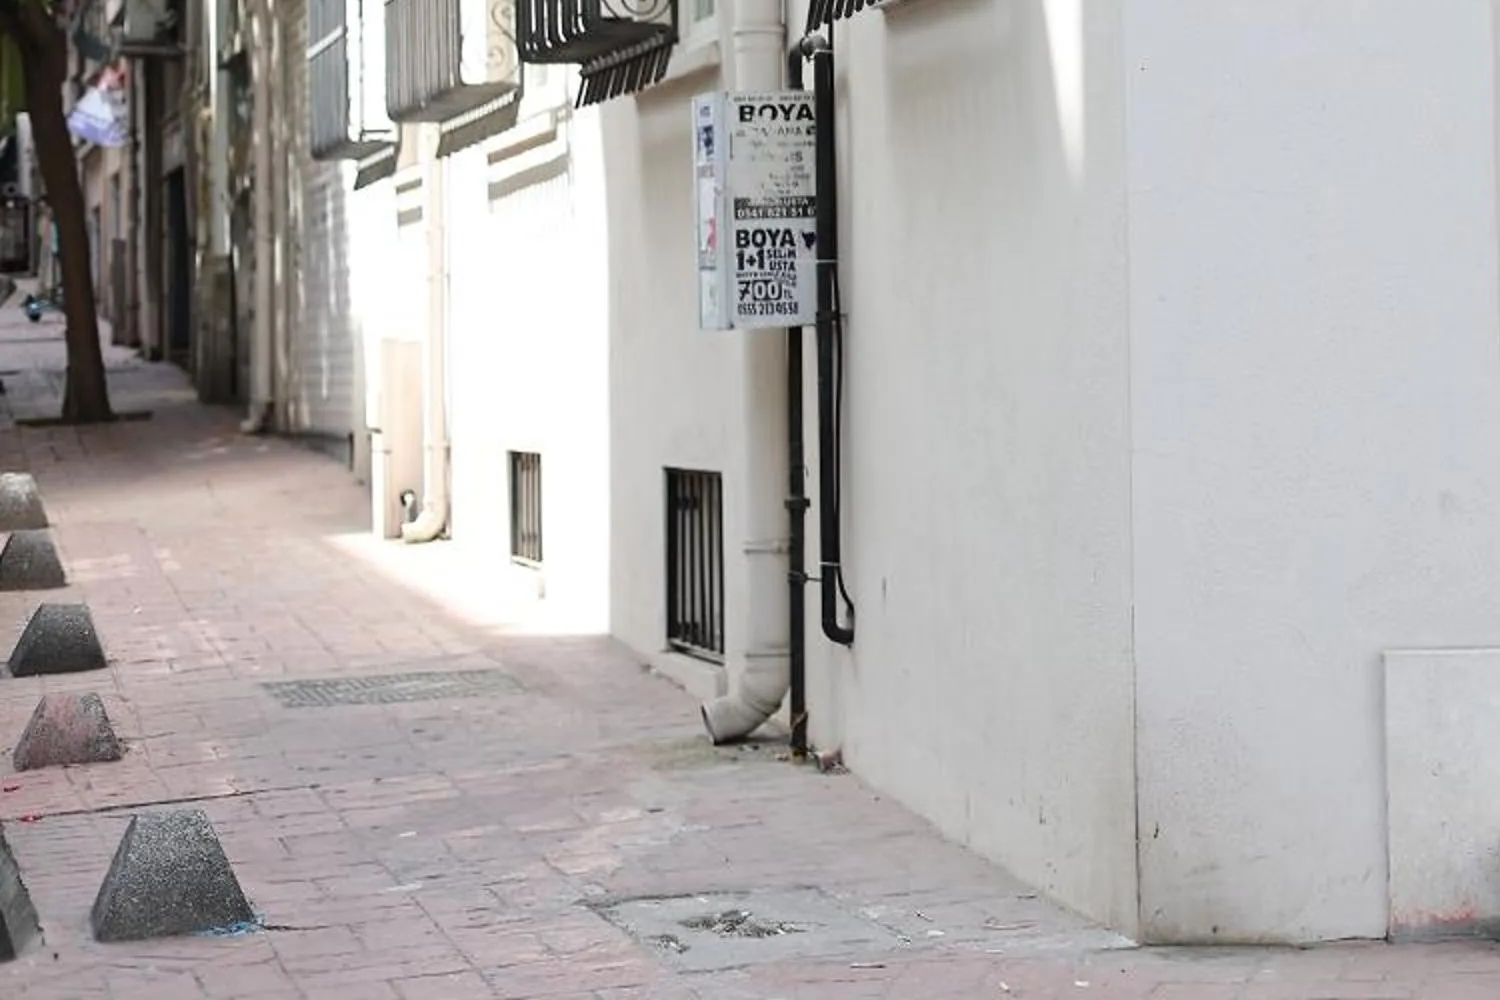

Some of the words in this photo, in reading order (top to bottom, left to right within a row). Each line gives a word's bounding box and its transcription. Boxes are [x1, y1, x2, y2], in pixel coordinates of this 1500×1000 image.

[739, 103, 815, 122] BOYA
[736, 228, 796, 249] BOYA
[736, 249, 765, 271] 1+1
[769, 260, 796, 272] USTA
[738, 279, 782, 301] 700
